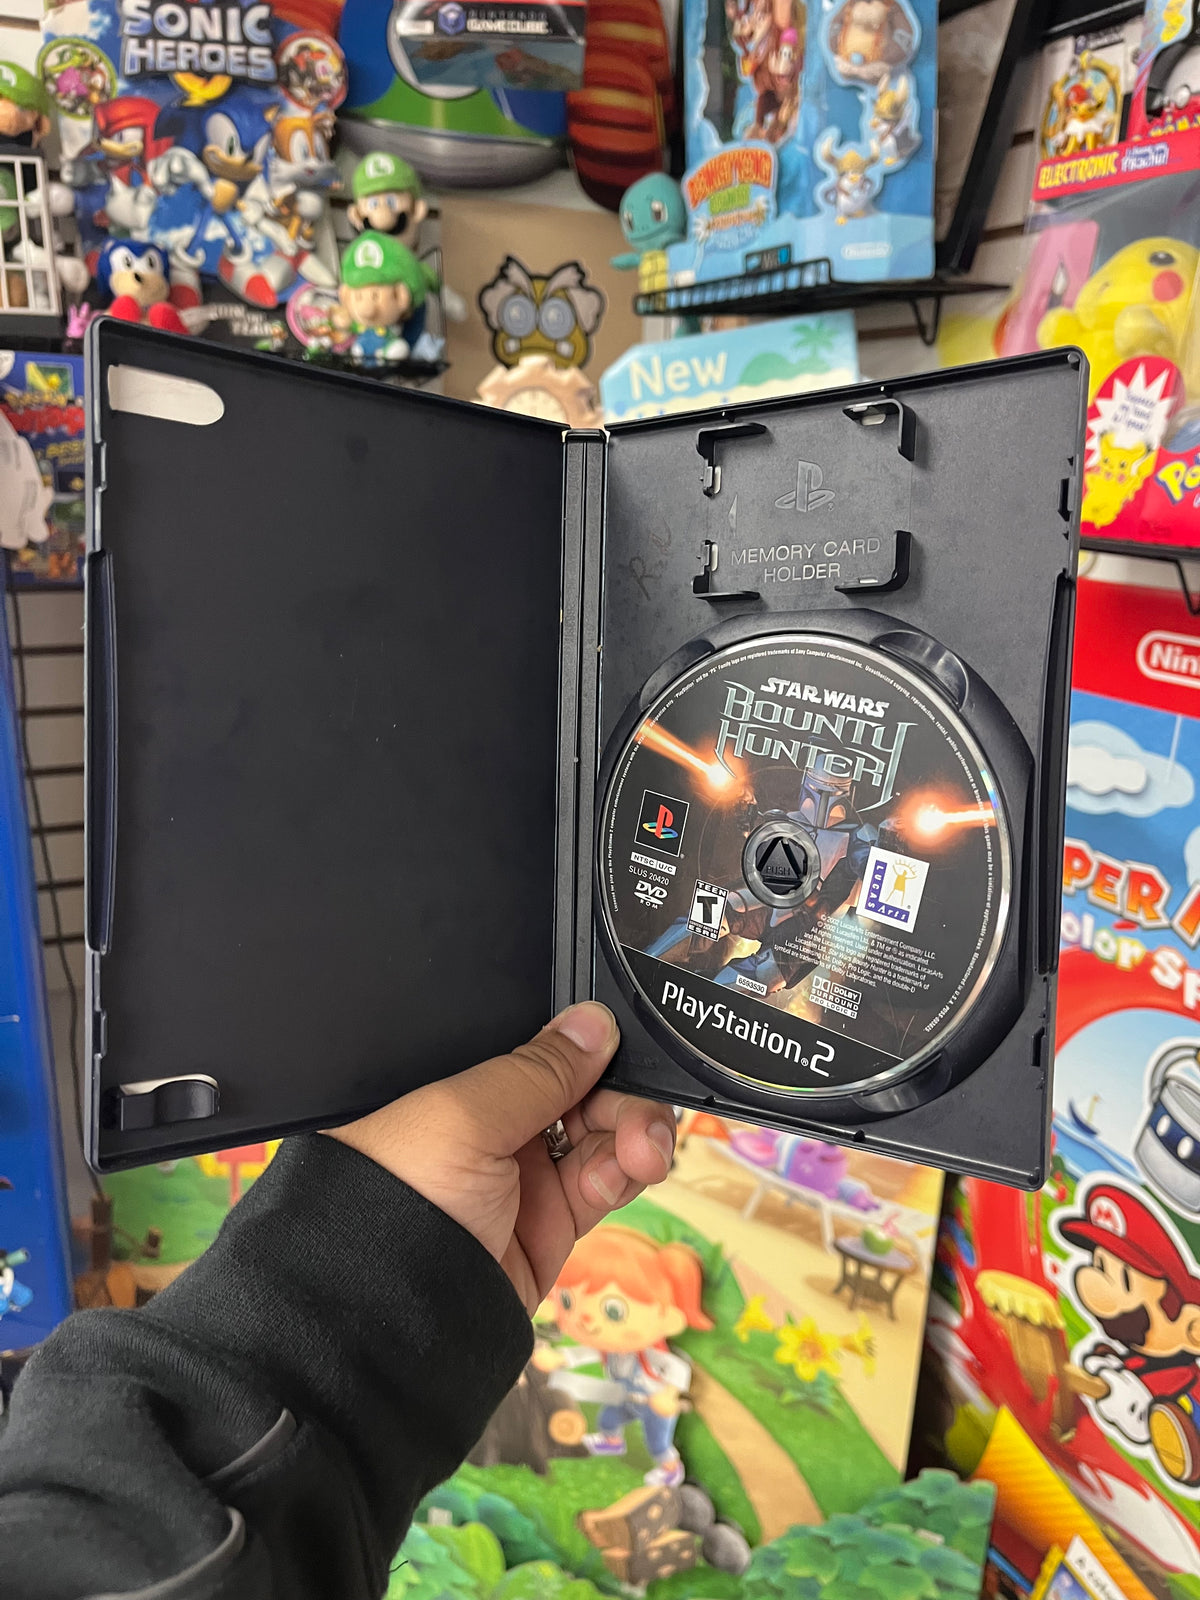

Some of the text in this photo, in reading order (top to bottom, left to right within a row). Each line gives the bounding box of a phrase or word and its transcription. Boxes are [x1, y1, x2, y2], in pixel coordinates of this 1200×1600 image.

[121, 0, 274, 45] SONIC
[124, 38, 277, 82] HEROES
[629, 352, 728, 400] New
[731, 537, 881, 566] MEMORY CARD
[763, 562, 841, 584] HOLDER
[806, 649, 826, 657] Computer
[1151, 641, 1200, 676] Nin
[760, 677, 890, 718] STAR WARS
[714, 718, 887, 787] HUNTER
[720, 680, 919, 813] BOUNTY
[628, 865, 670, 886] SLUS 20420
[633, 854, 674, 873] NTSC U/C
[766, 865, 791, 876] PUSH
[635, 880, 668, 899] DVD
[698, 881, 727, 898] TEEN
[867, 865, 885, 909] LUCAS
[1062, 836, 1171, 929] PER
[639, 899, 658, 910] ROM
[697, 896, 718, 924] T
[877, 904, 907, 921] Arts
[688, 924, 718, 940] ESRB
[840, 920, 864, 933] LucasArts
[864, 929, 899, 946] Entertainment
[898, 941, 924, 955] Company
[875, 941, 885, 949] TM
[1061, 911, 1146, 971] olor
[773, 943, 792, 955] symbol
[830, 964, 846, 975] Dolby
[784, 940, 799, 950] Lucas
[798, 945, 822, 959] Licensing
[891, 979, 916, 993] double-D
[794, 935, 818, 949] Lucasfilm
[827, 948, 840, 957] Star
[839, 952, 852, 961] Wars
[851, 956, 870, 968] Bounty
[869, 963, 887, 974] Hunter
[895, 973, 923, 987] trademark
[817, 929, 832, 939] rights
[867, 947, 883, 957] under
[916, 964, 944, 979] LucasArts
[821, 938, 846, 951] LucasArts
[845, 946, 857, 956] logo
[865, 954, 890, 968] registered
[890, 963, 920, 978] trademarks
[738, 977, 765, 994] 6593530
[811, 989, 859, 1011] SURROUND
[833, 986, 858, 1001] DOLBY
[810, 996, 825, 1005] PRO
[826, 1002, 848, 1015] LOGIC
[661, 980, 836, 1078] PlayStation 2
